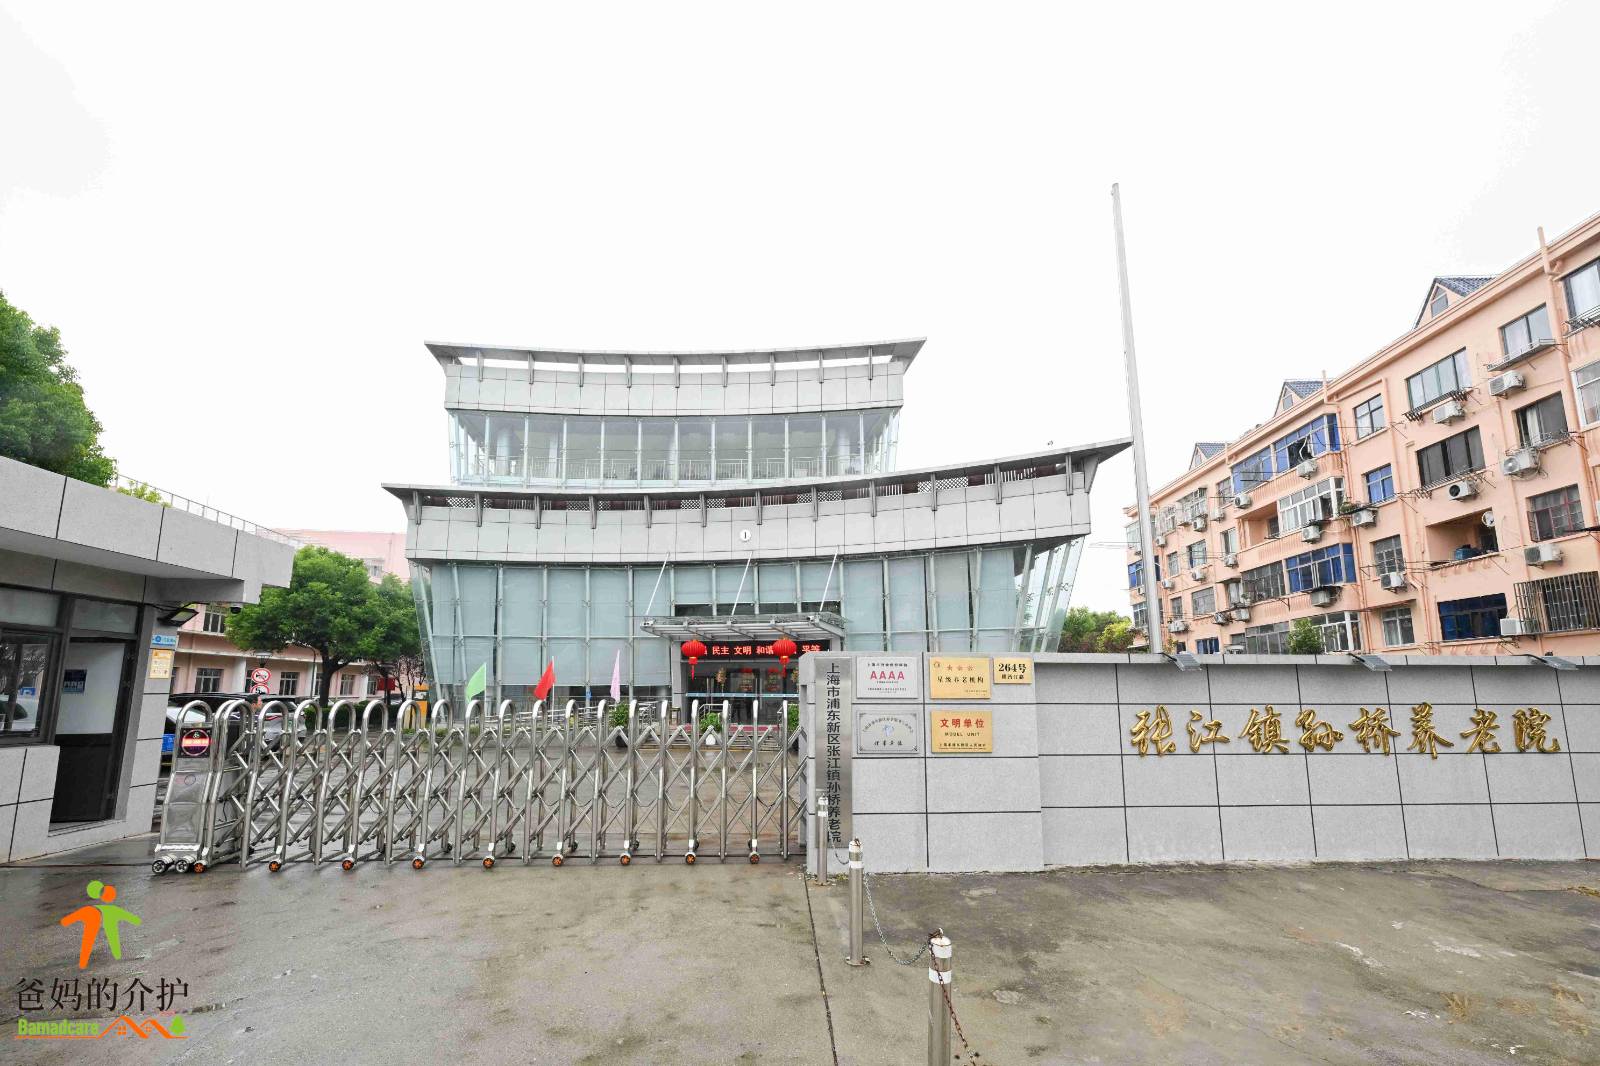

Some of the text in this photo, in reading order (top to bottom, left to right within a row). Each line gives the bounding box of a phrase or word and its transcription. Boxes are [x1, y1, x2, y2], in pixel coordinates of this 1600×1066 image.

[712, 645, 730, 655] 民主
[734, 645, 752, 655] 文明
[998, 663, 1027, 674] 264号
[870, 670, 905, 680] AAAA
[939, 717, 985, 729] 文明单位
[1129, 702, 1561, 759] 张江镇孙桥养老院
[826, 662, 842, 843] 上海市浦东新区张江镇孙桥养老院
